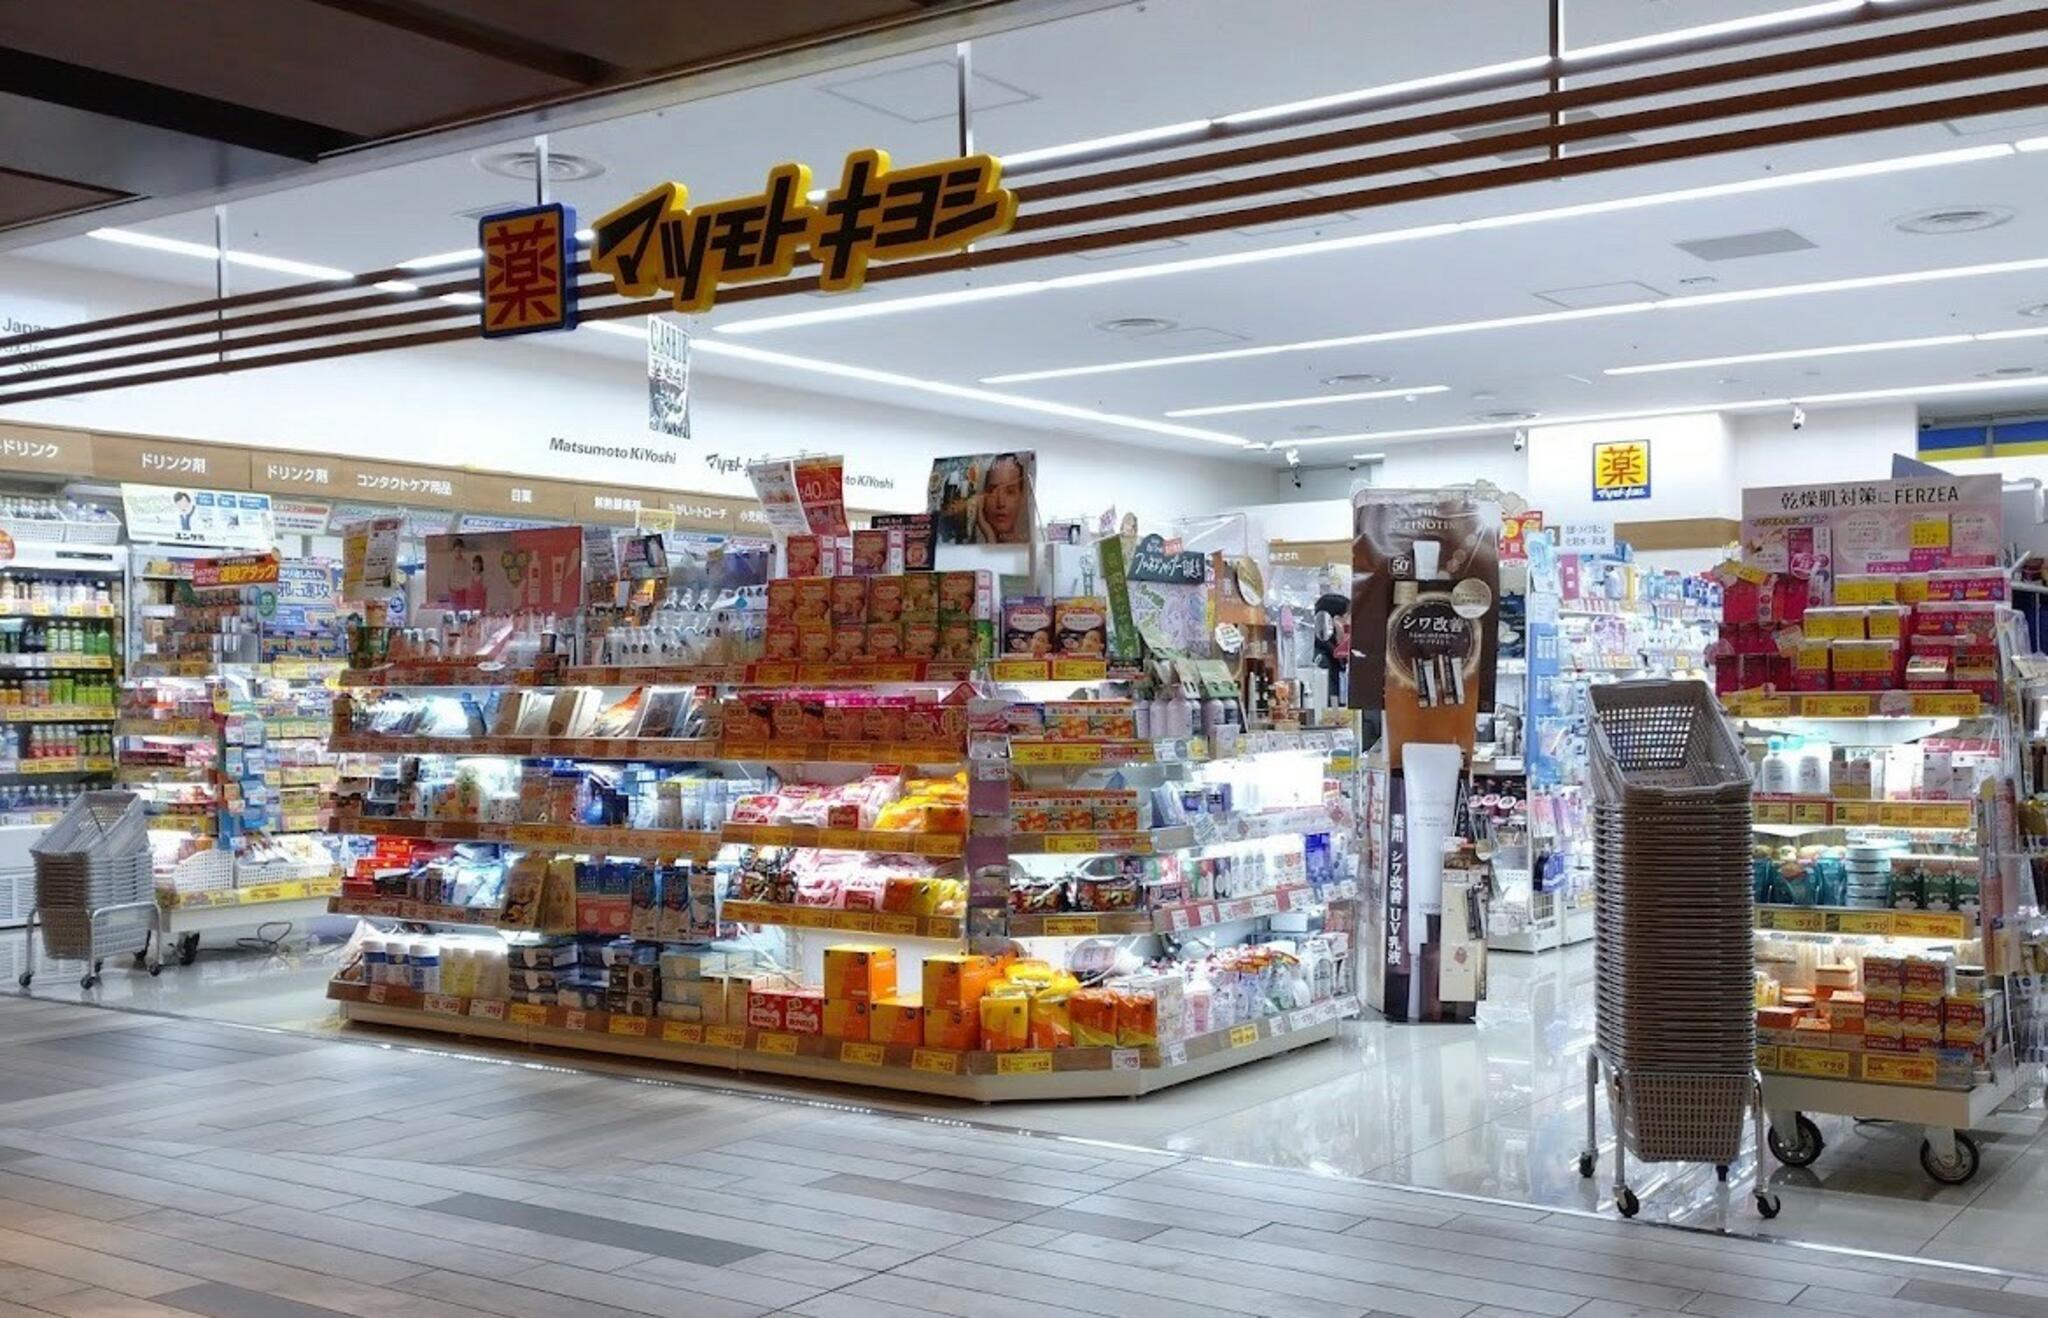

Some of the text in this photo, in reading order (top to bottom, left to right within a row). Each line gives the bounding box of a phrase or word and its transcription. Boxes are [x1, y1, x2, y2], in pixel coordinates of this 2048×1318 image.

[598, 161, 1002, 301] マツモトキヨシ
[488, 218, 557, 326] 薬
[0, 439, 59, 459] ドリンク
[549, 437, 677, 465] Matsumoto KiYoshi
[141, 453, 206, 474] ドリンク剤
[266, 464, 329, 484] ドリンク剤
[1602, 445, 1641, 486] 薬
[1403, 616, 1464, 632] シワ改善
